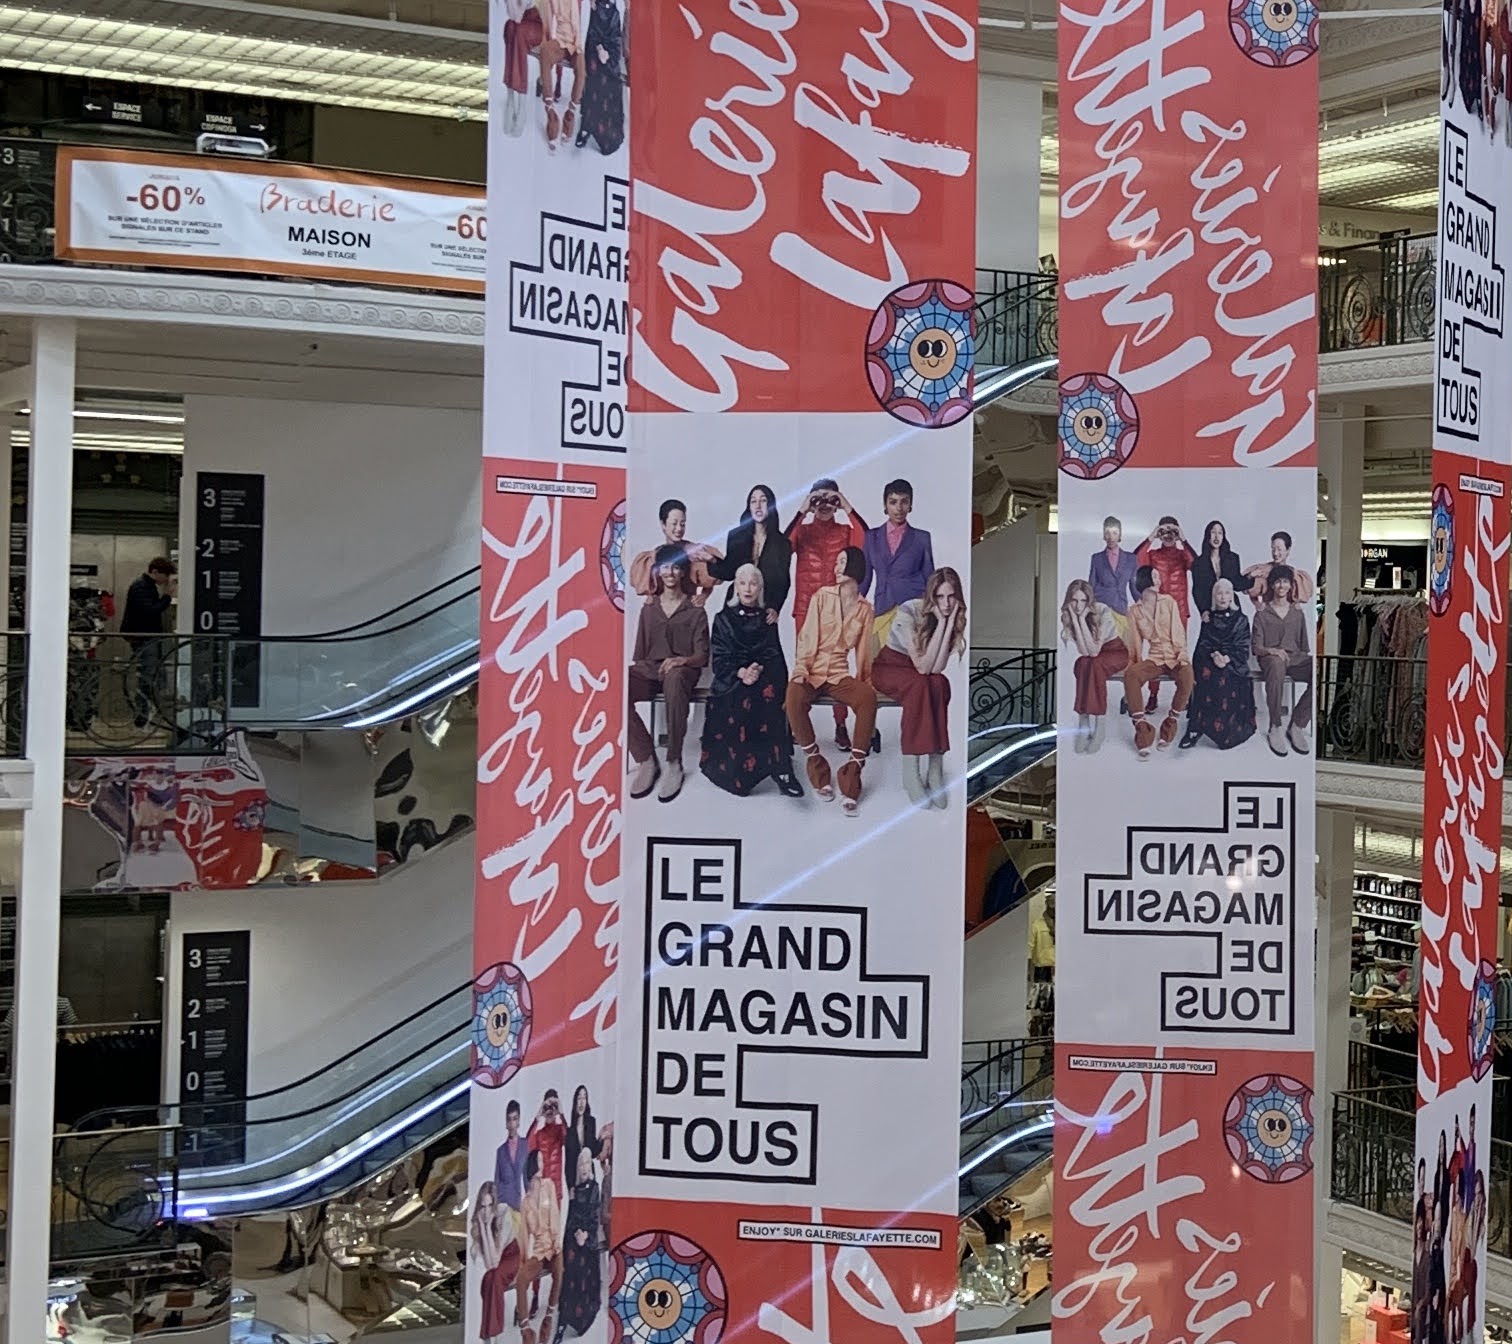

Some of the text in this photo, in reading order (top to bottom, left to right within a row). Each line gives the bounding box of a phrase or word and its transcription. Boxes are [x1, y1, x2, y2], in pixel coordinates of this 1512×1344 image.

[112, 102, 142, 113] ESPACE
[2, 147, 15, 165] 3
[1447, 140, 1464, 188] LE
[126, 183, 206, 212] -60%
[260, 182, 396, 223] Braderie
[287, 225, 371, 249] MAISON
[1328, 222, 1341, 238] &
[1446, 201, 1490, 260] GRAND
[1443, 319, 1461, 363] DE
[1441, 377, 1478, 426] TOUS
[202, 488, 215, 508] 3
[201, 538, 214, 558] 2
[201, 570, 210, 590] 1
[200, 611, 213, 631] 0
[659, 856, 725, 902] LE
[189, 948, 202, 968] 3
[657, 922, 852, 972] GRAND
[188, 999, 201, 1019] 2
[656, 987, 909, 1040] MAGASIN
[188, 1031, 197, 1050] 1
[186, 1071, 200, 1091] 0
[655, 1051, 727, 1098] DE
[652, 1115, 800, 1166] TOUS
[783, 1226, 803, 1237] SUR
[805, 1228, 938, 1245] GALERIESLAFAYETTE.COM
